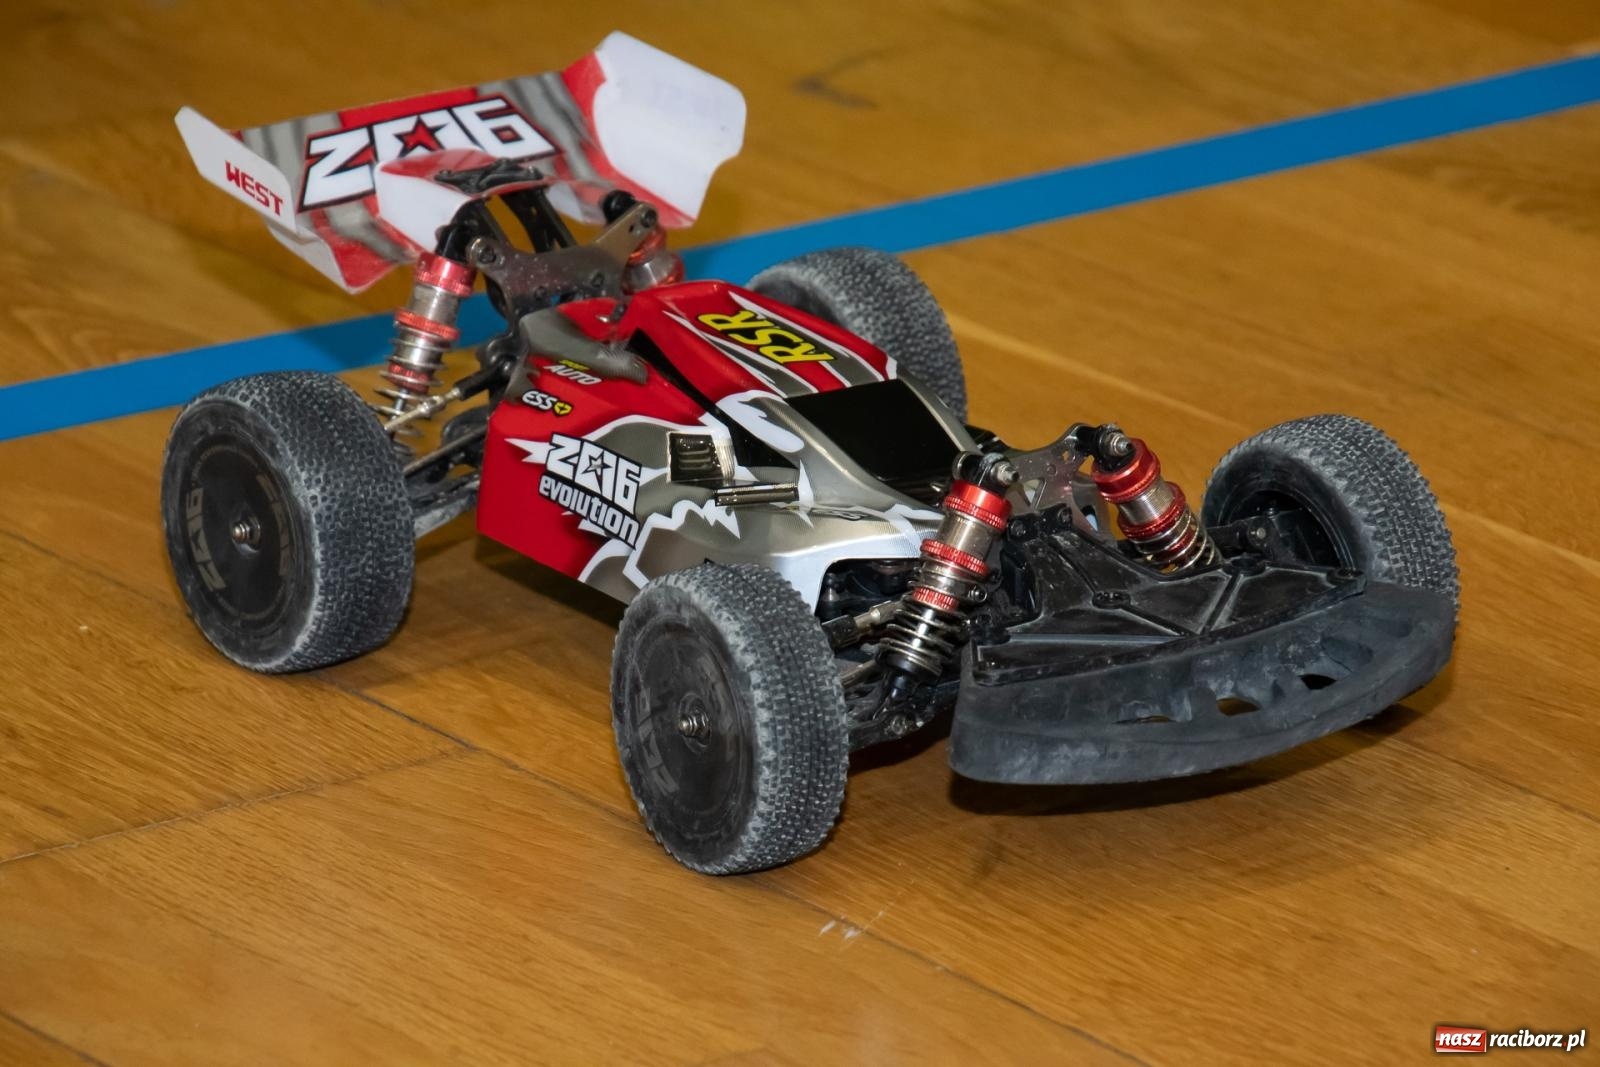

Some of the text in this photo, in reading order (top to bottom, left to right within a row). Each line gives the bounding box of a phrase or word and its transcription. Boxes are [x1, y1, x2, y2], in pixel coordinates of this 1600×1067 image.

[225, 160, 284, 217] WEST
[698, 310, 834, 363] RSR
[543, 365, 602, 385] AUTO
[539, 475, 640, 549] evolution
